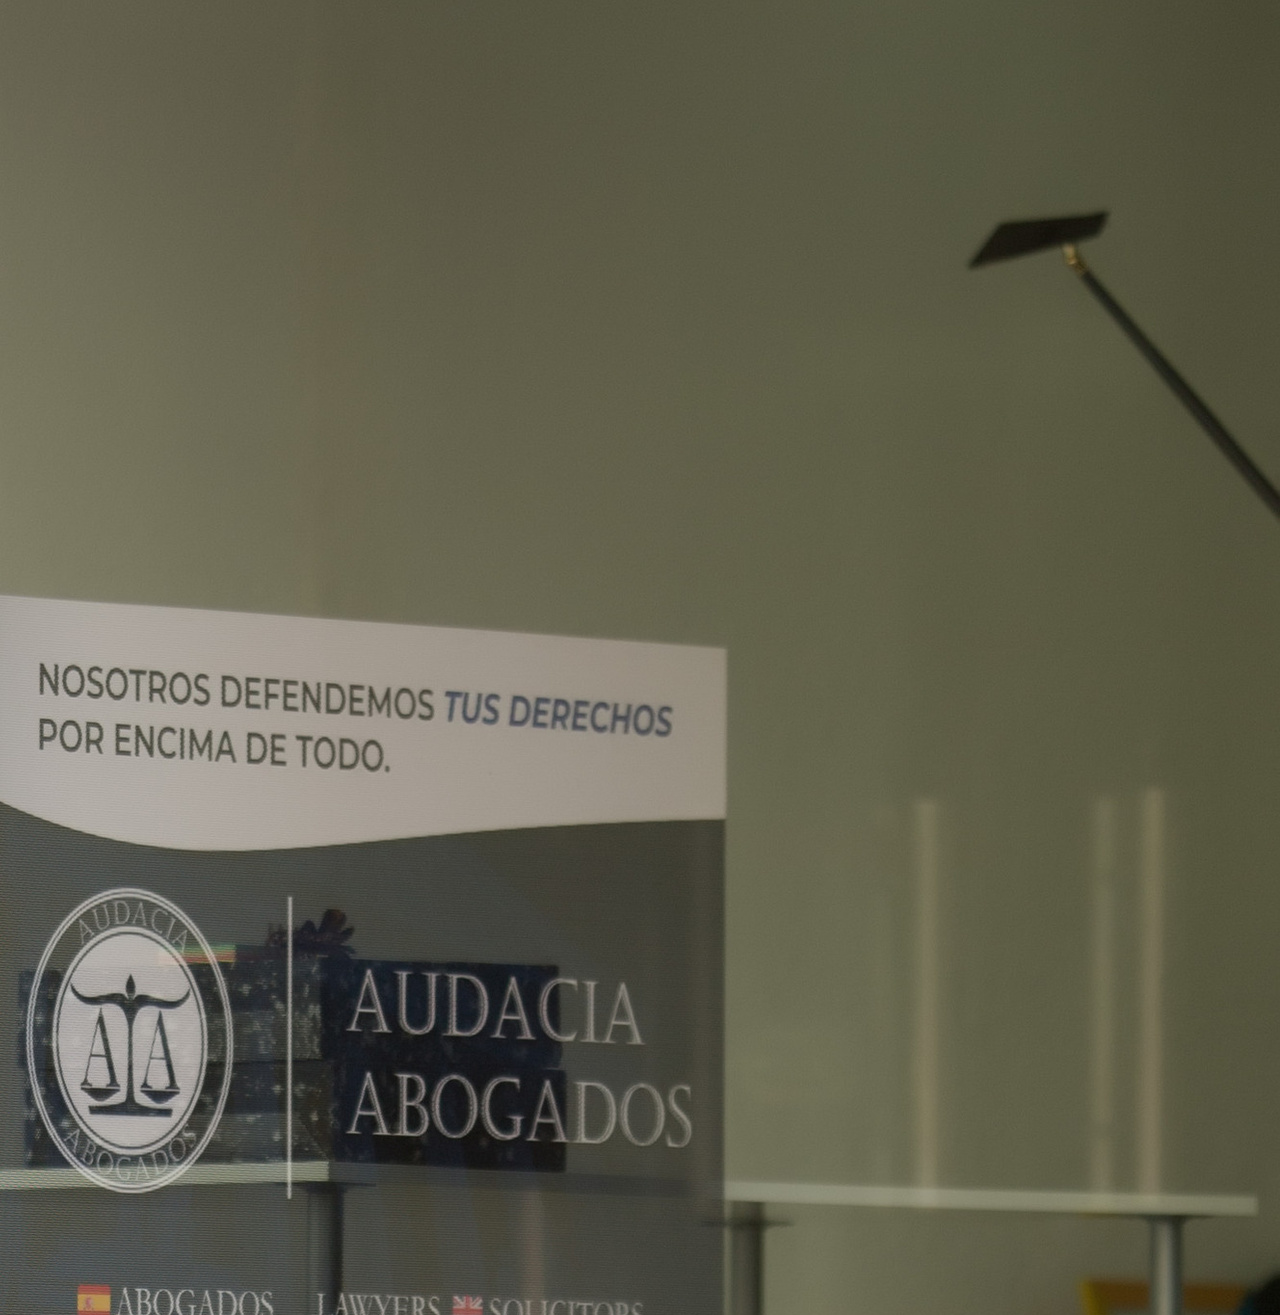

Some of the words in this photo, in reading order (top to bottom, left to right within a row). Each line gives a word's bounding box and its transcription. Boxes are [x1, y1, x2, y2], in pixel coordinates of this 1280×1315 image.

[38, 662, 211, 707] NOSOTROS
[220, 674, 436, 721] DEFENDEMOS
[444, 690, 501, 726] TUS
[508, 694, 674, 738] DERECHOS
[38, 717, 105, 755] POR
[114, 722, 237, 764] ENCIMA
[246, 731, 287, 767] DE
[295, 734, 391, 773] TODO.
[78, 901, 189, 955] AUDACIA
[345, 968, 644, 1046] AUDACIA
[345, 1070, 692, 1148] ABOGADOS
[63, 1122, 198, 1182] ABOGADOS
